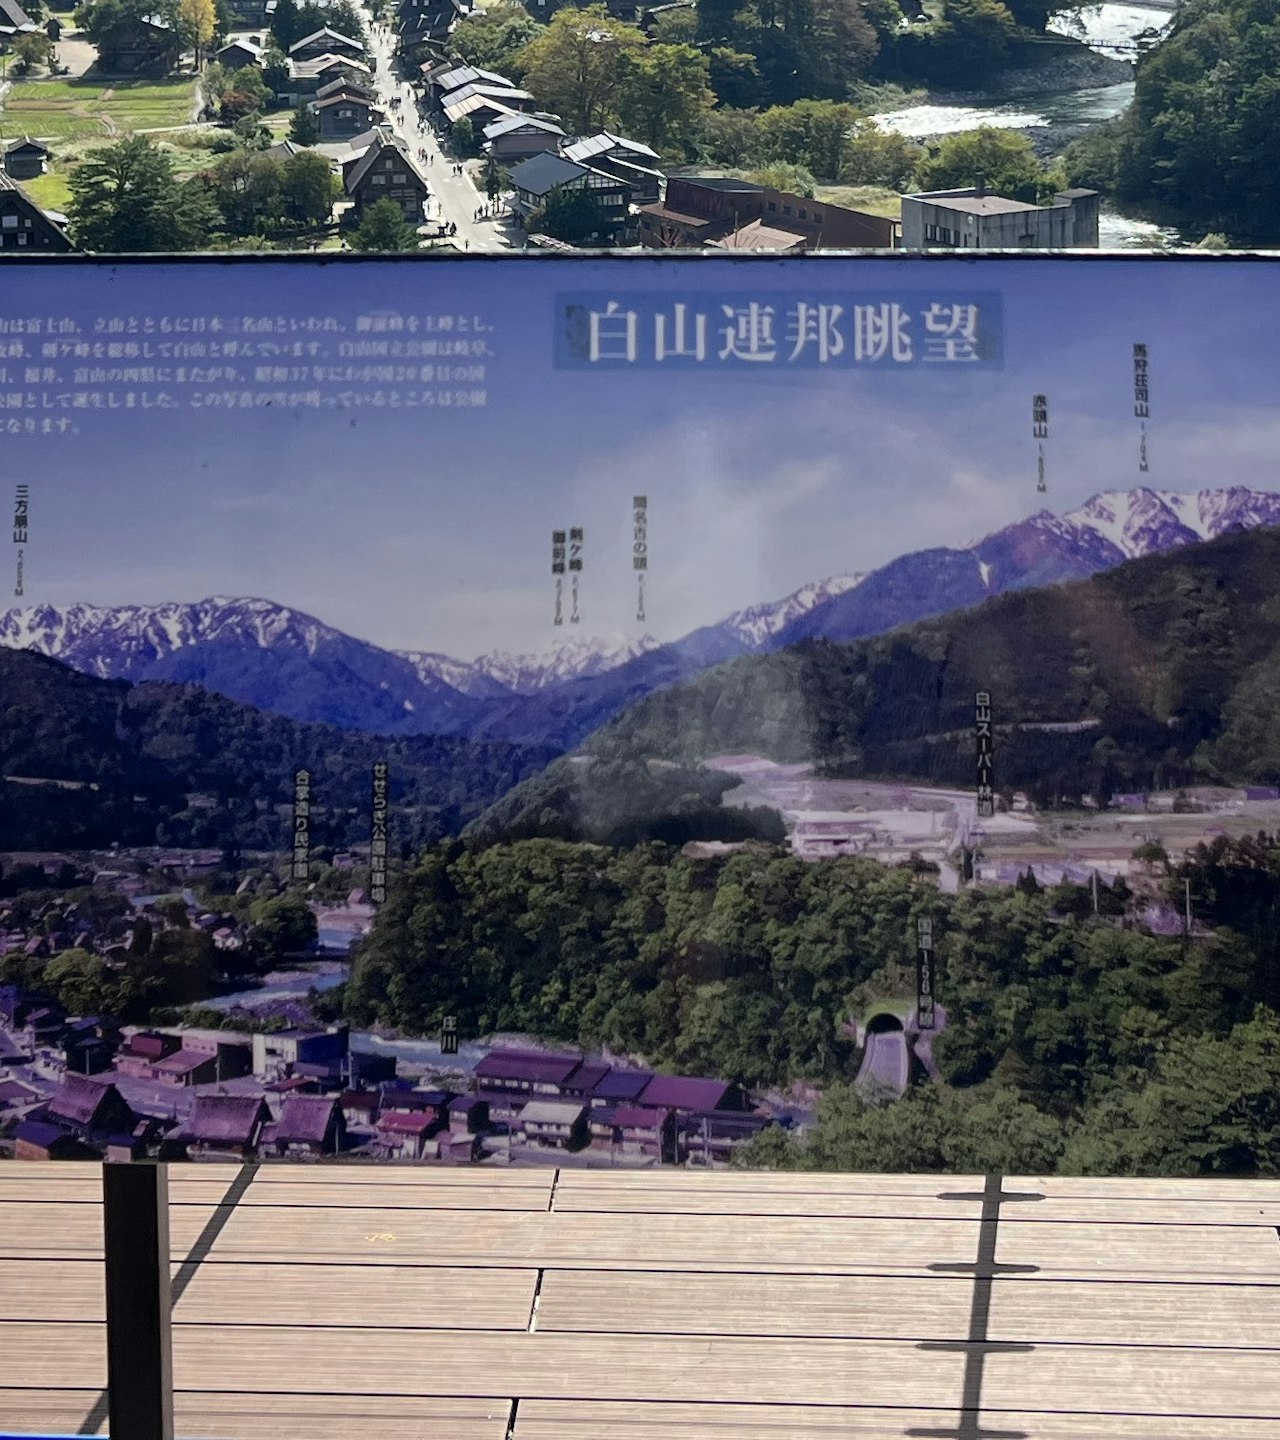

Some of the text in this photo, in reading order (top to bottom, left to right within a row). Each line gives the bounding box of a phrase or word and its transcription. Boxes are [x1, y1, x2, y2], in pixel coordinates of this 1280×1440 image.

[588, 301, 980, 362] 白山連邦眺望
[443, 1015, 457, 1051] 庄川
